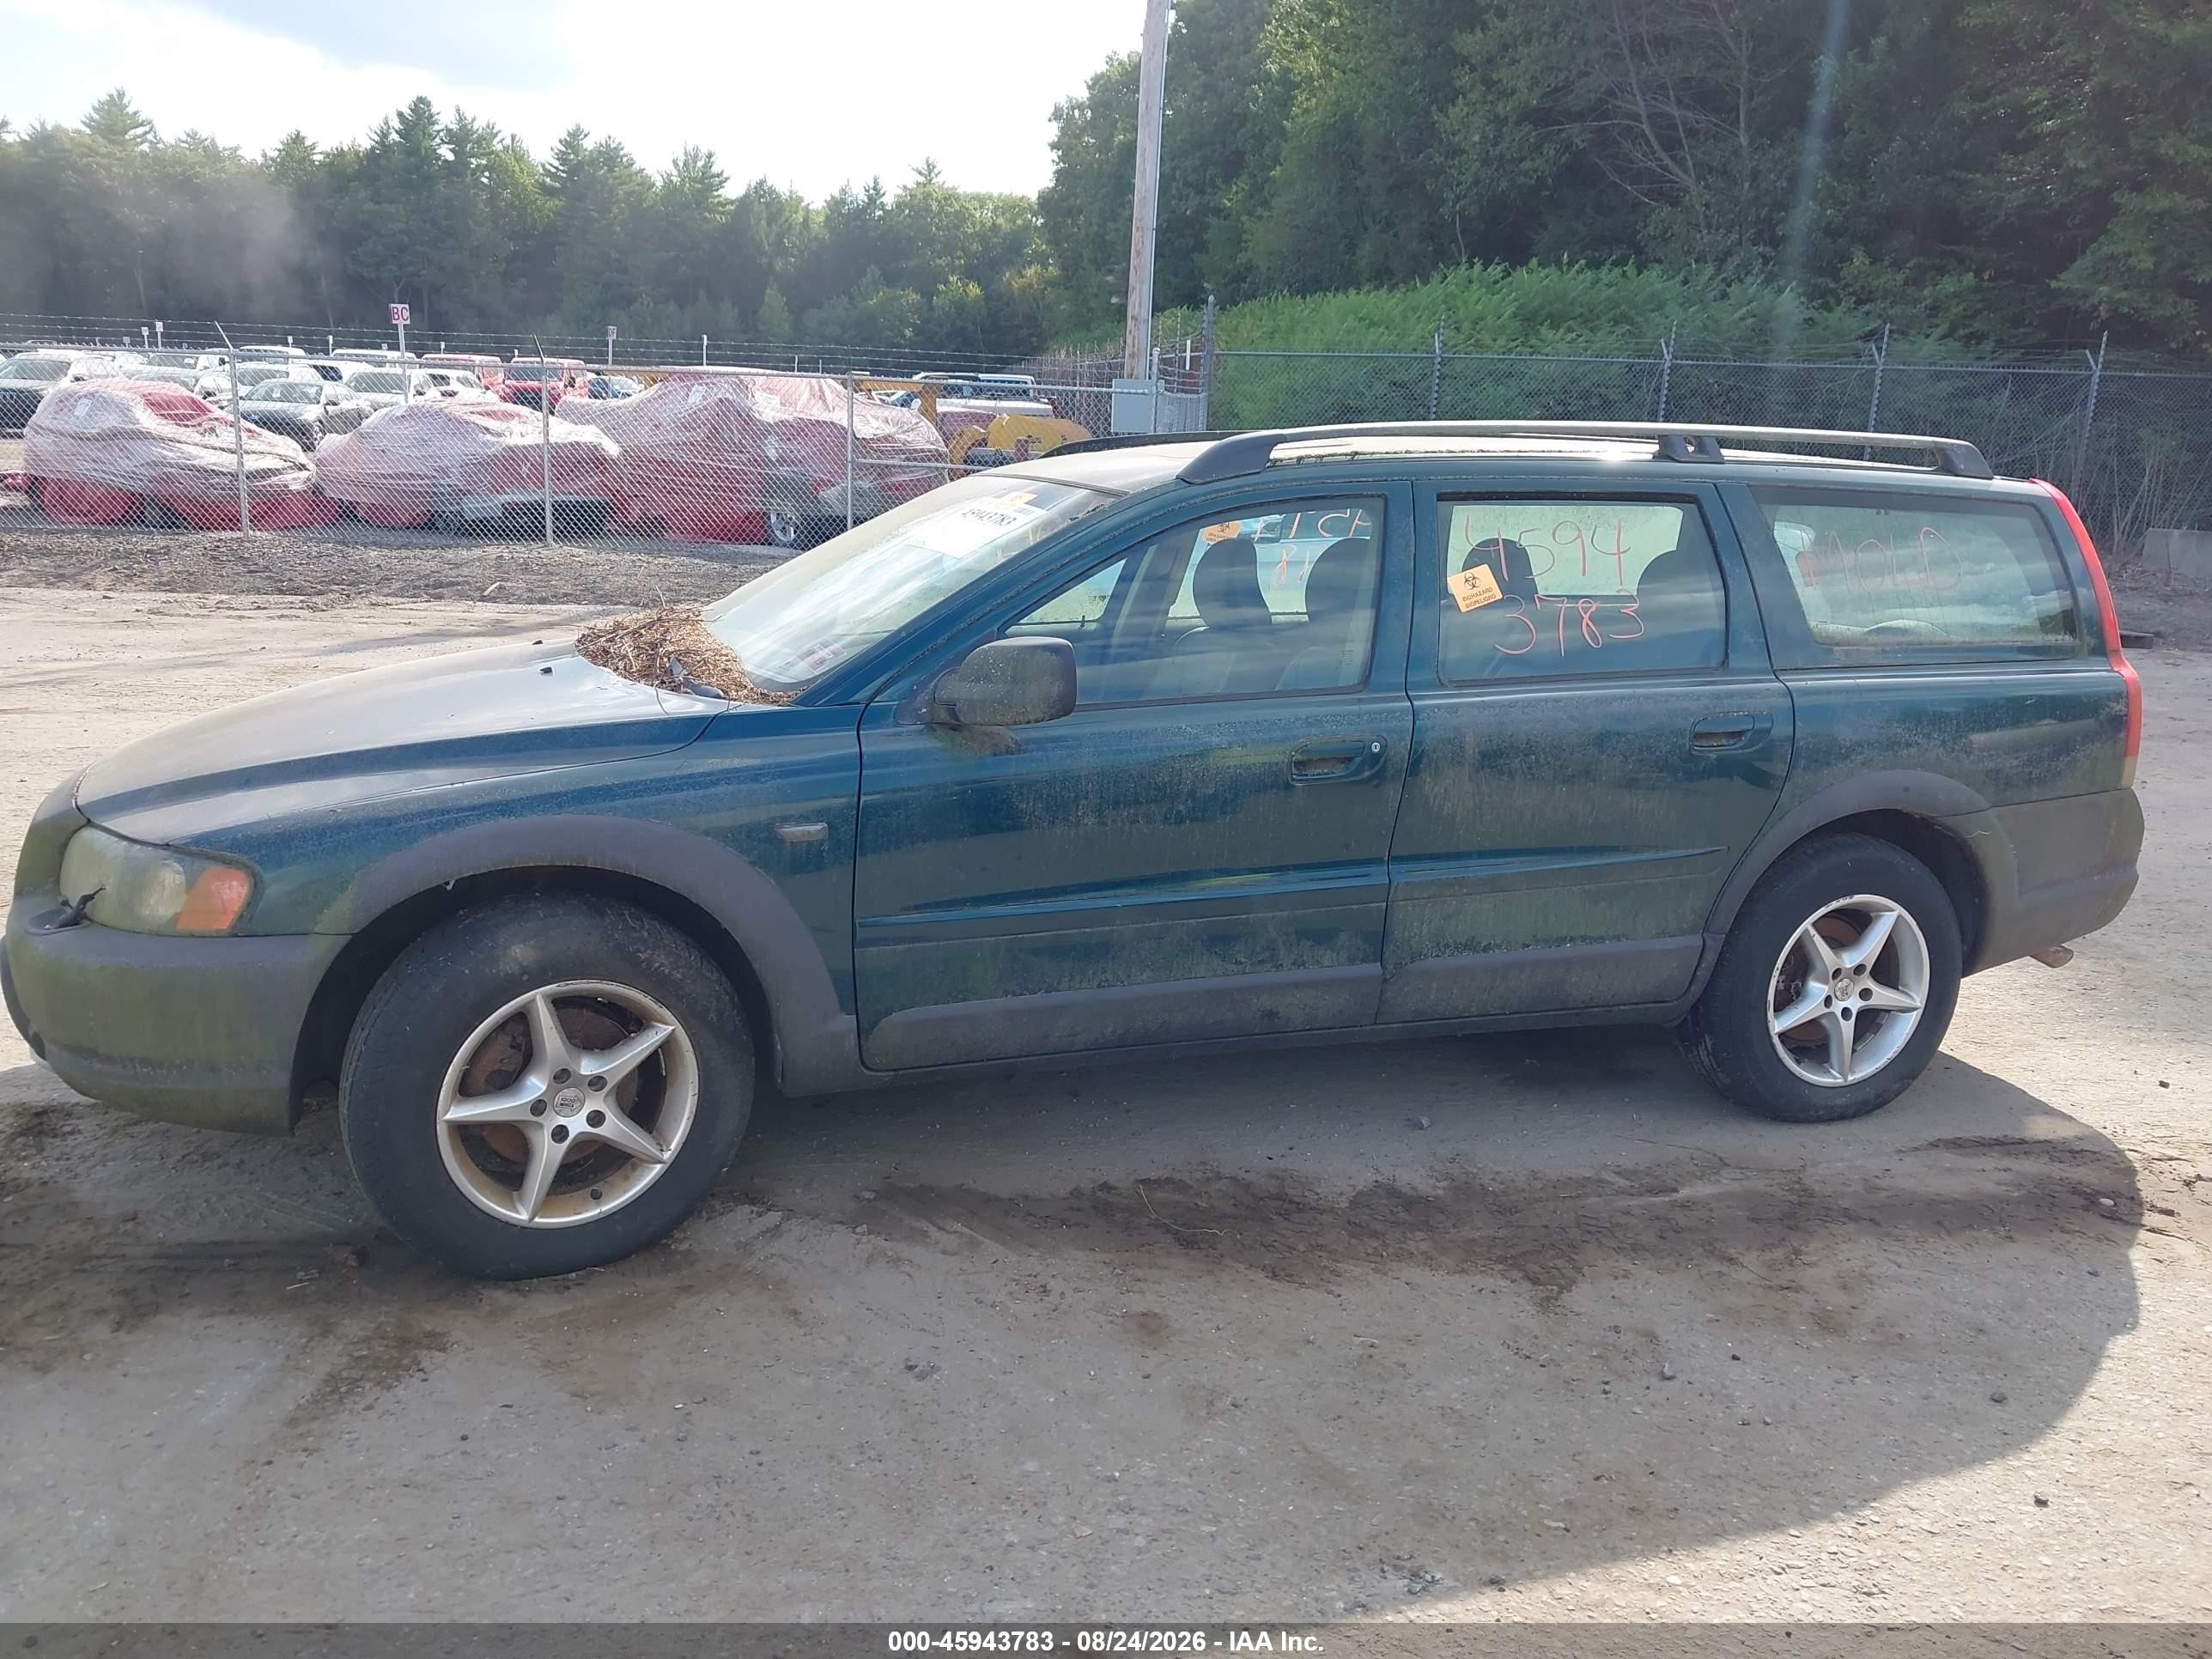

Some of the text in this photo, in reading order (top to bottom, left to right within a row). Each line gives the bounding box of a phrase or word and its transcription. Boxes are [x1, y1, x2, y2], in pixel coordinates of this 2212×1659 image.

[392, 307, 409, 321] BC
[1464, 513, 1632, 587] 4594
[1799, 526, 1964, 594] MOLD
[1462, 586, 1493, 602] BIOHAZARD
[1494, 587, 1645, 658] 3783
